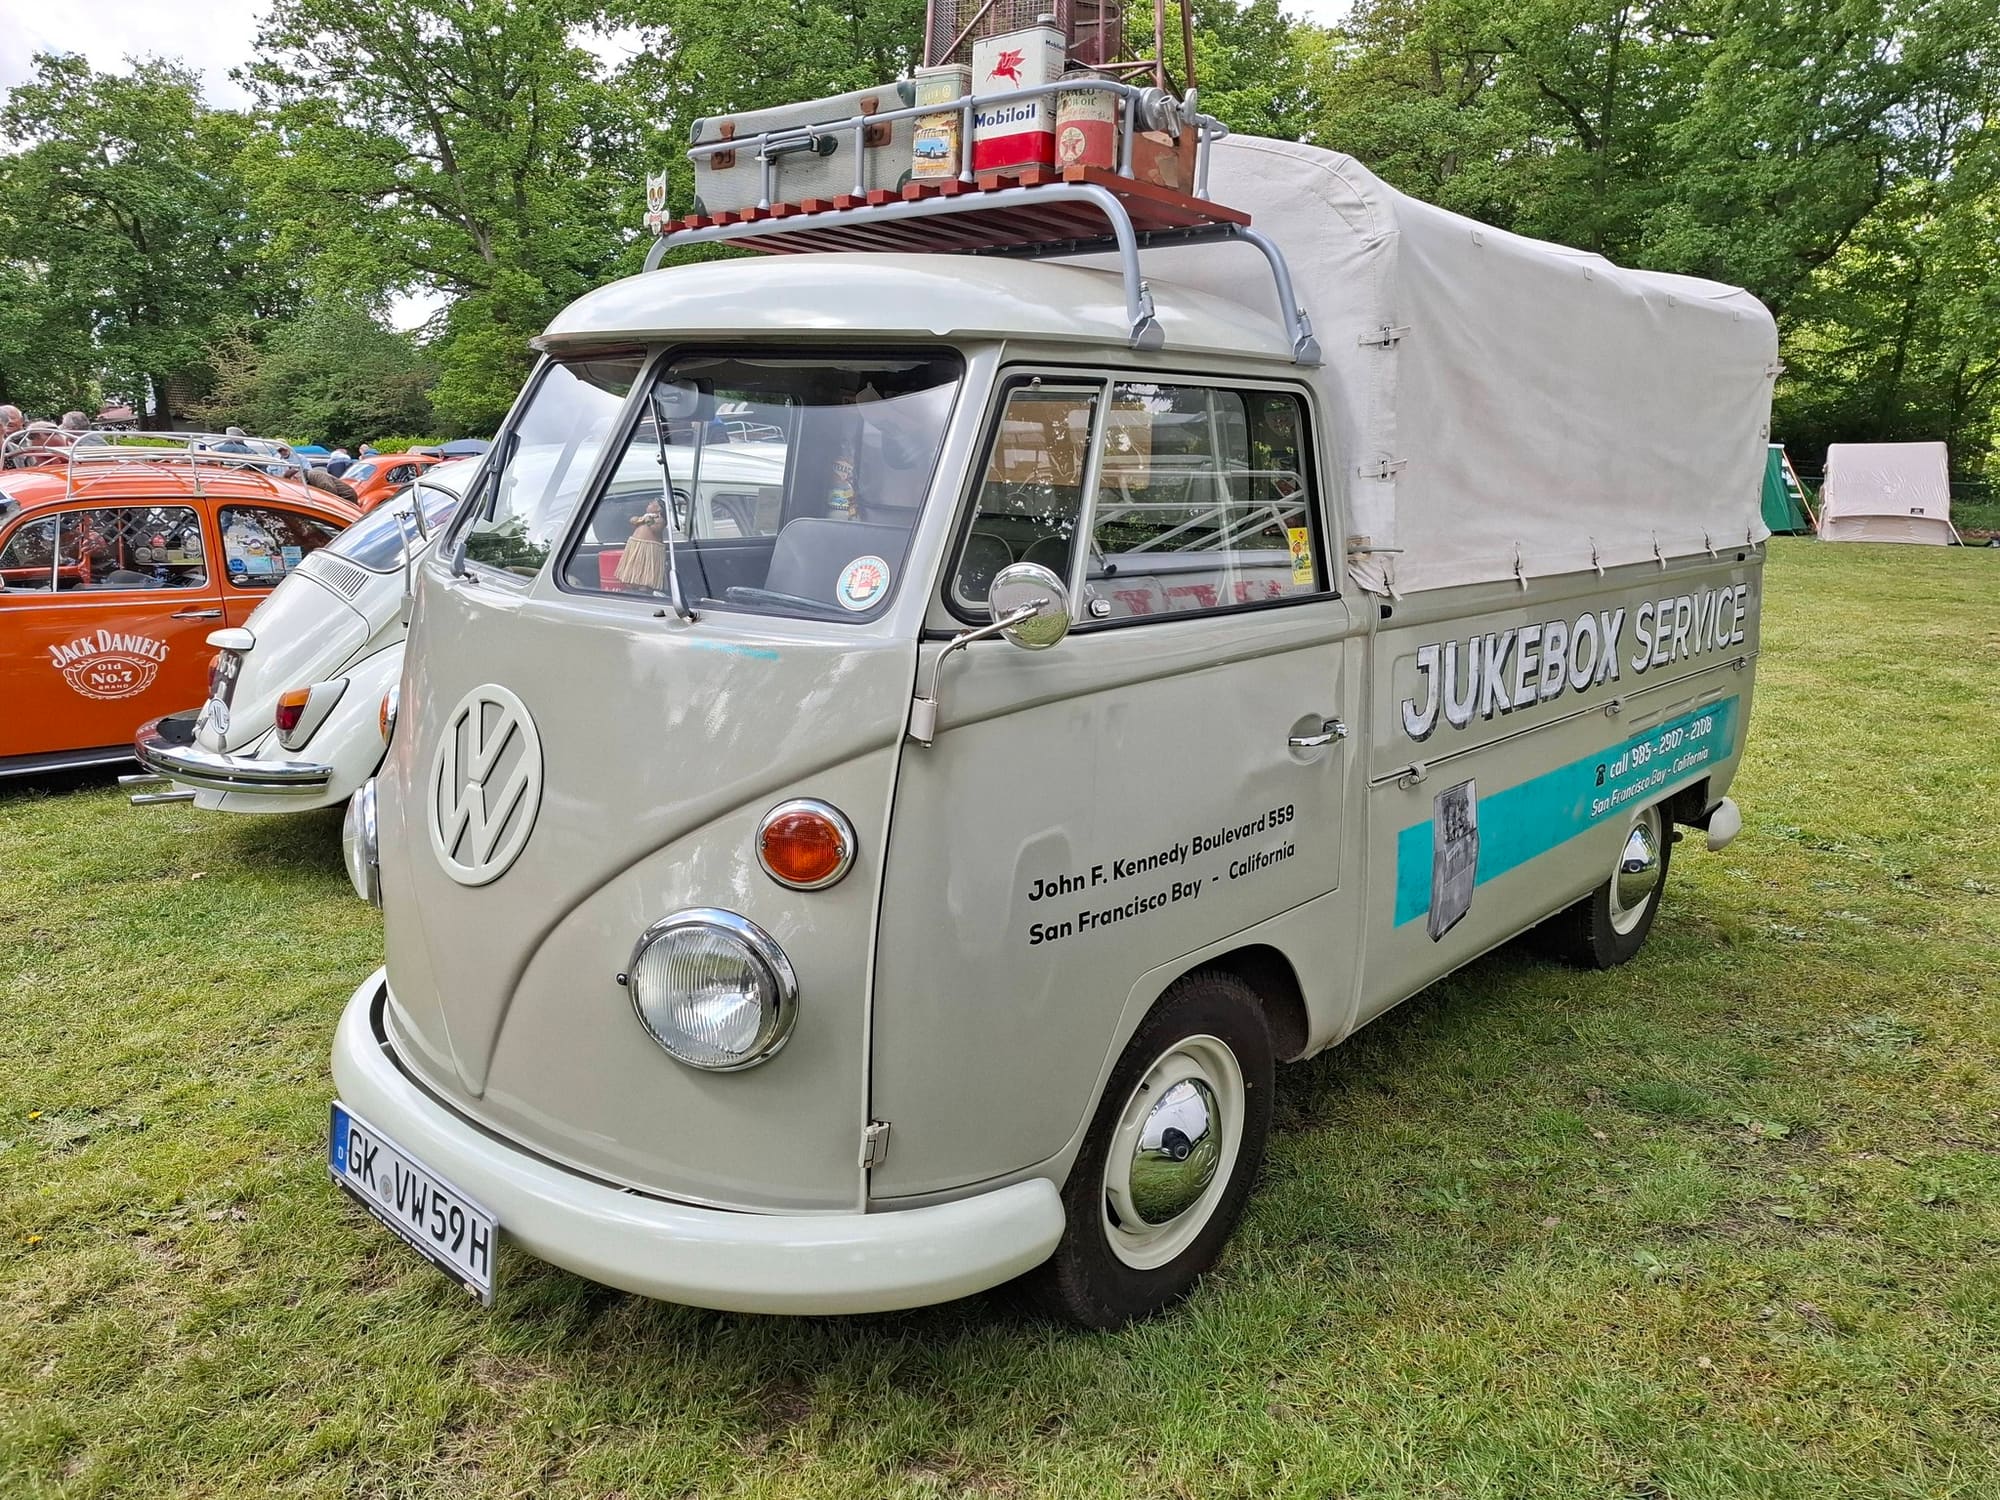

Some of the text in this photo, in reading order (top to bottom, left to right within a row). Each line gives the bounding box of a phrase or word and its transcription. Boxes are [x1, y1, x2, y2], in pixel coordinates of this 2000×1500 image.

[974, 103, 1036, 129] Mobiloil
[48, 629, 170, 669] JACK DANIEL'S
[97, 663, 122, 671] Old
[1402, 583, 1747, 743] JUKEBOX SERVICE
[1591, 797, 1610, 818] San
[1611, 777, 1650, 807] Francisco
[1651, 768, 1668, 785] Bay
[1672, 746, 1709, 775] California
[1610, 752, 1629, 779] call
[1028, 804, 1294, 902] John F. Kennedy Boulevard 559
[1029, 920, 1072, 945] San
[1078, 890, 1167, 933] Francisco
[1171, 879, 1201, 903] Bay
[1229, 841, 1295, 880] California
[349, 1128, 378, 1191] GK
